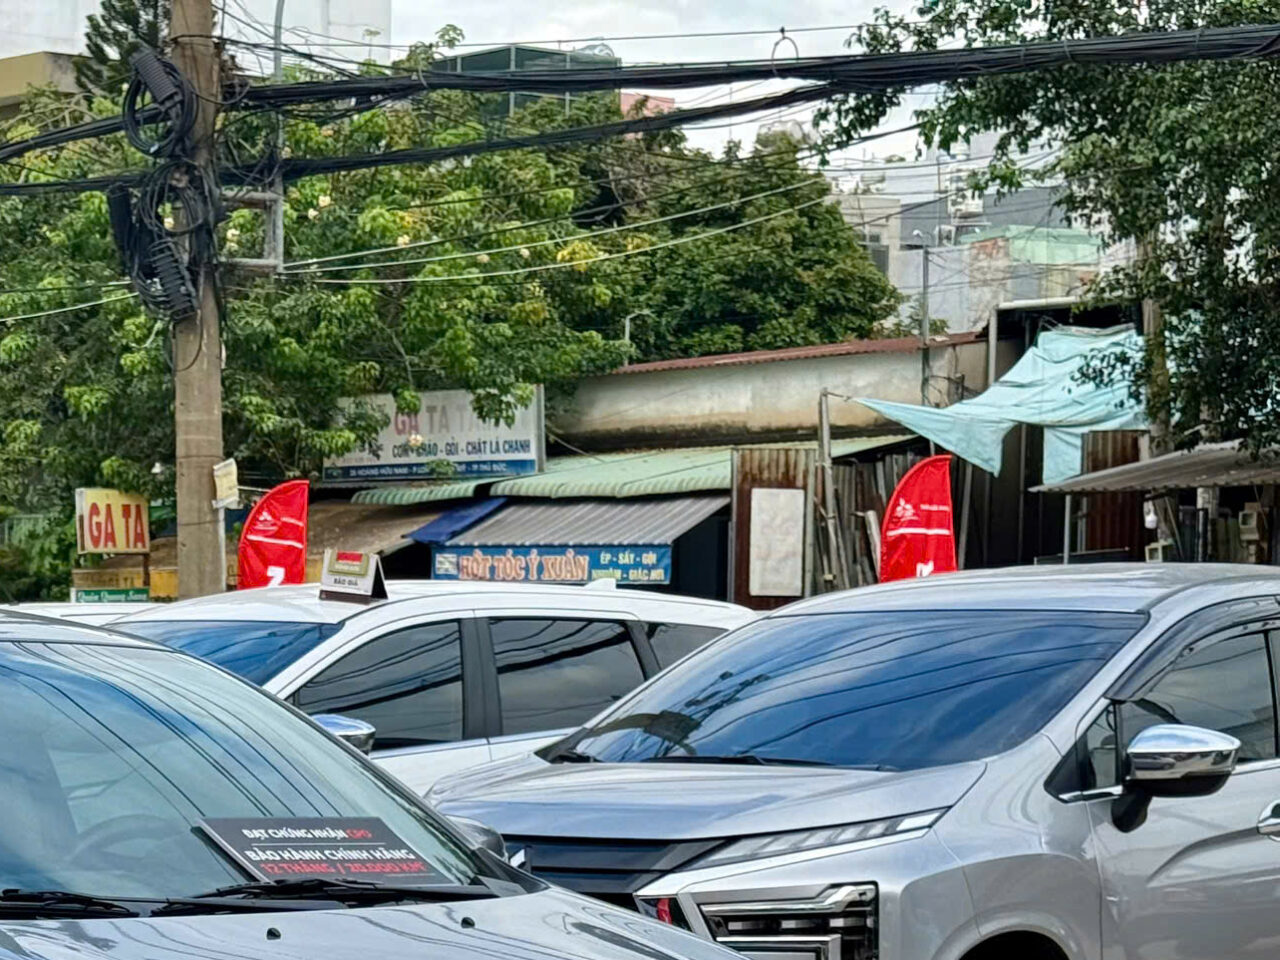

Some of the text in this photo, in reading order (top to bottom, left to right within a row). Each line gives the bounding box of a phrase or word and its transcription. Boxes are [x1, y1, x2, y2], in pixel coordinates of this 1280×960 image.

[121, 503, 146, 549] TA
[246, 847, 416, 862] BẢO HÀNH CHÍNH HÃNG
